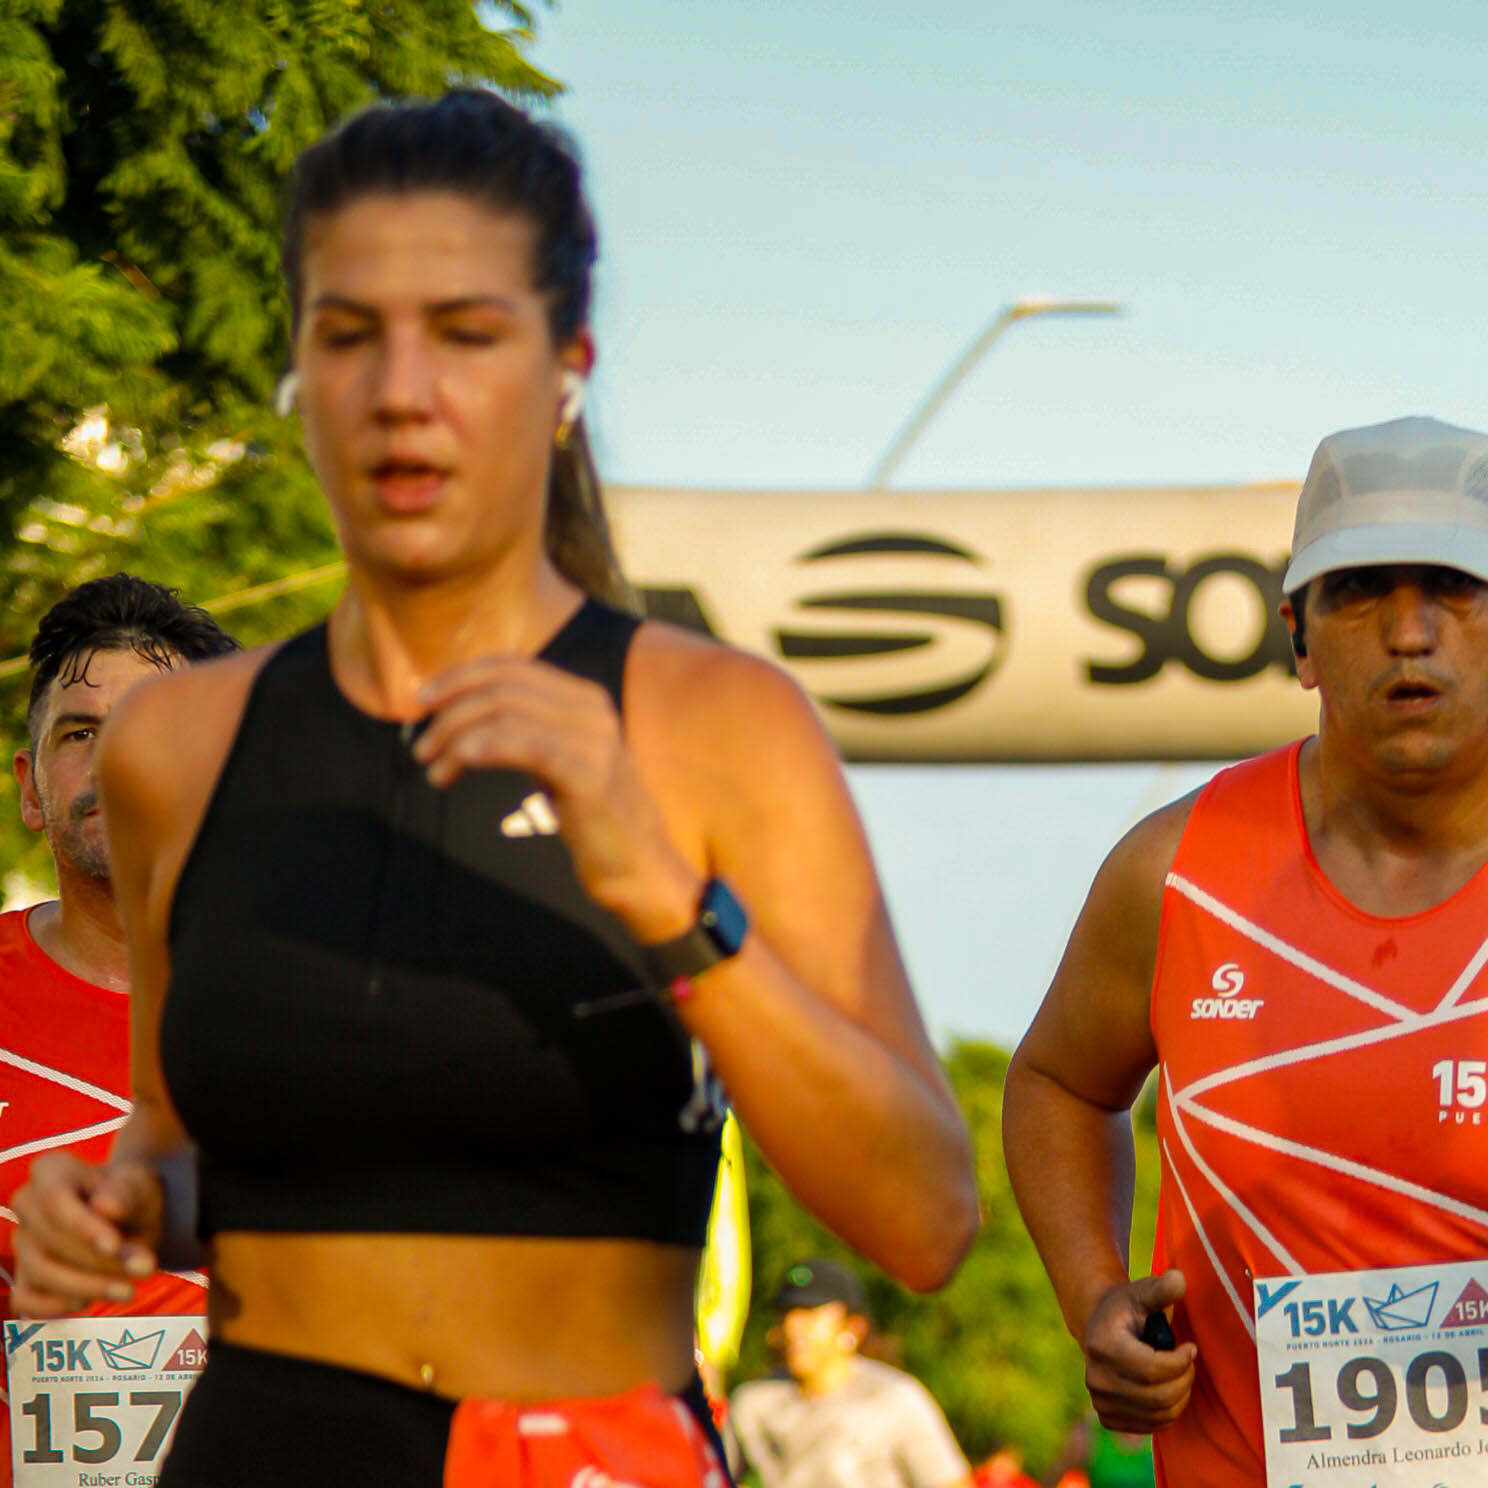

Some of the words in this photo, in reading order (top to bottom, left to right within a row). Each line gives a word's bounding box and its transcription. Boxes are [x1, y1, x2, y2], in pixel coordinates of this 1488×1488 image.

[1283, 1297, 1359, 1337] 15K
[30, 1339, 93, 1372] 15K
[1286, 1341, 1320, 1350] PUERTO
[1322, 1339, 1349, 1348] NORTE
[1383, 1333, 1421, 1343] ROSARIO
[1307, 1448, 1387, 1470] Almendra
[1393, 1441, 1471, 1463] Leonardo
[79, 1472, 121, 1487] Ruber
